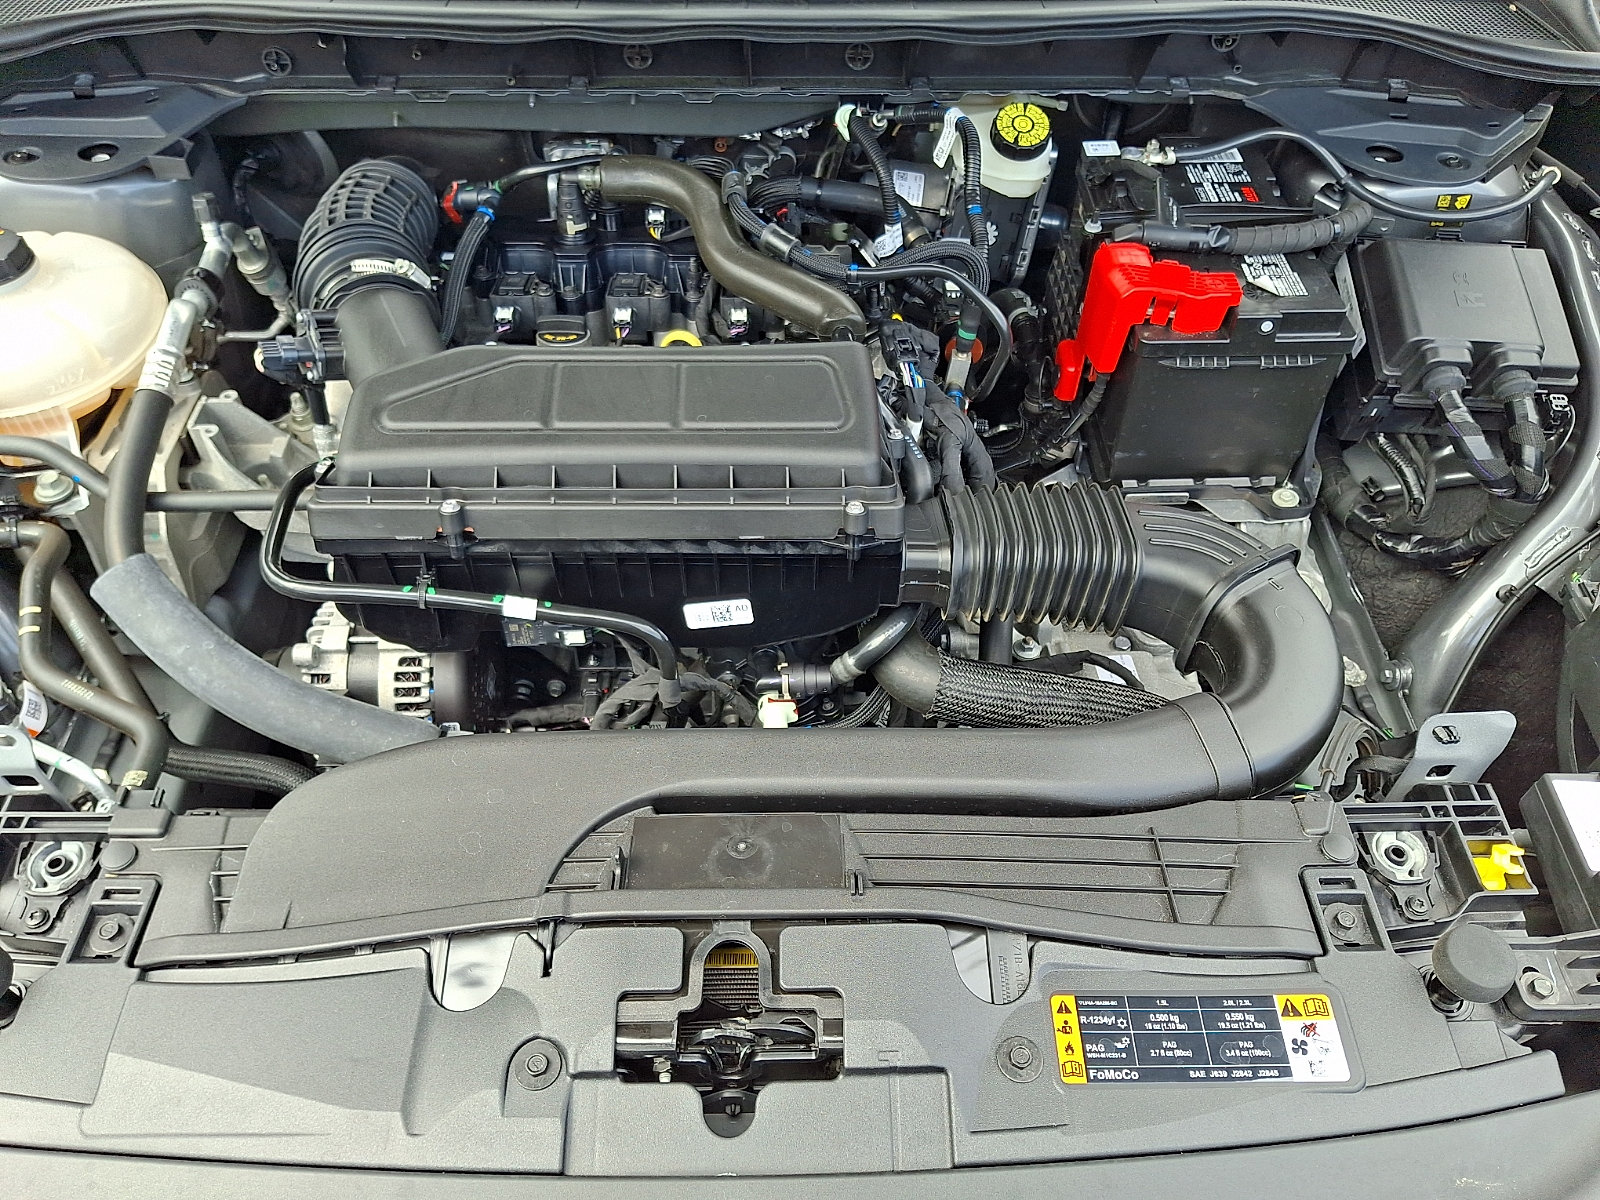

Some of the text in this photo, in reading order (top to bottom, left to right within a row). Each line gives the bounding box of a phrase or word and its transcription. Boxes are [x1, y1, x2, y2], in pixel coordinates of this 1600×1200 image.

[1169, 1014, 1180, 1023] kg
[1225, 1013, 1255, 1022] 0.550 kg
[1085, 1044, 1106, 1053] PAG
[1162, 1041, 1177, 1049] PAG
[1089, 1069, 1140, 1080] FoMoCo
[1189, 1070, 1207, 1078] SAE
